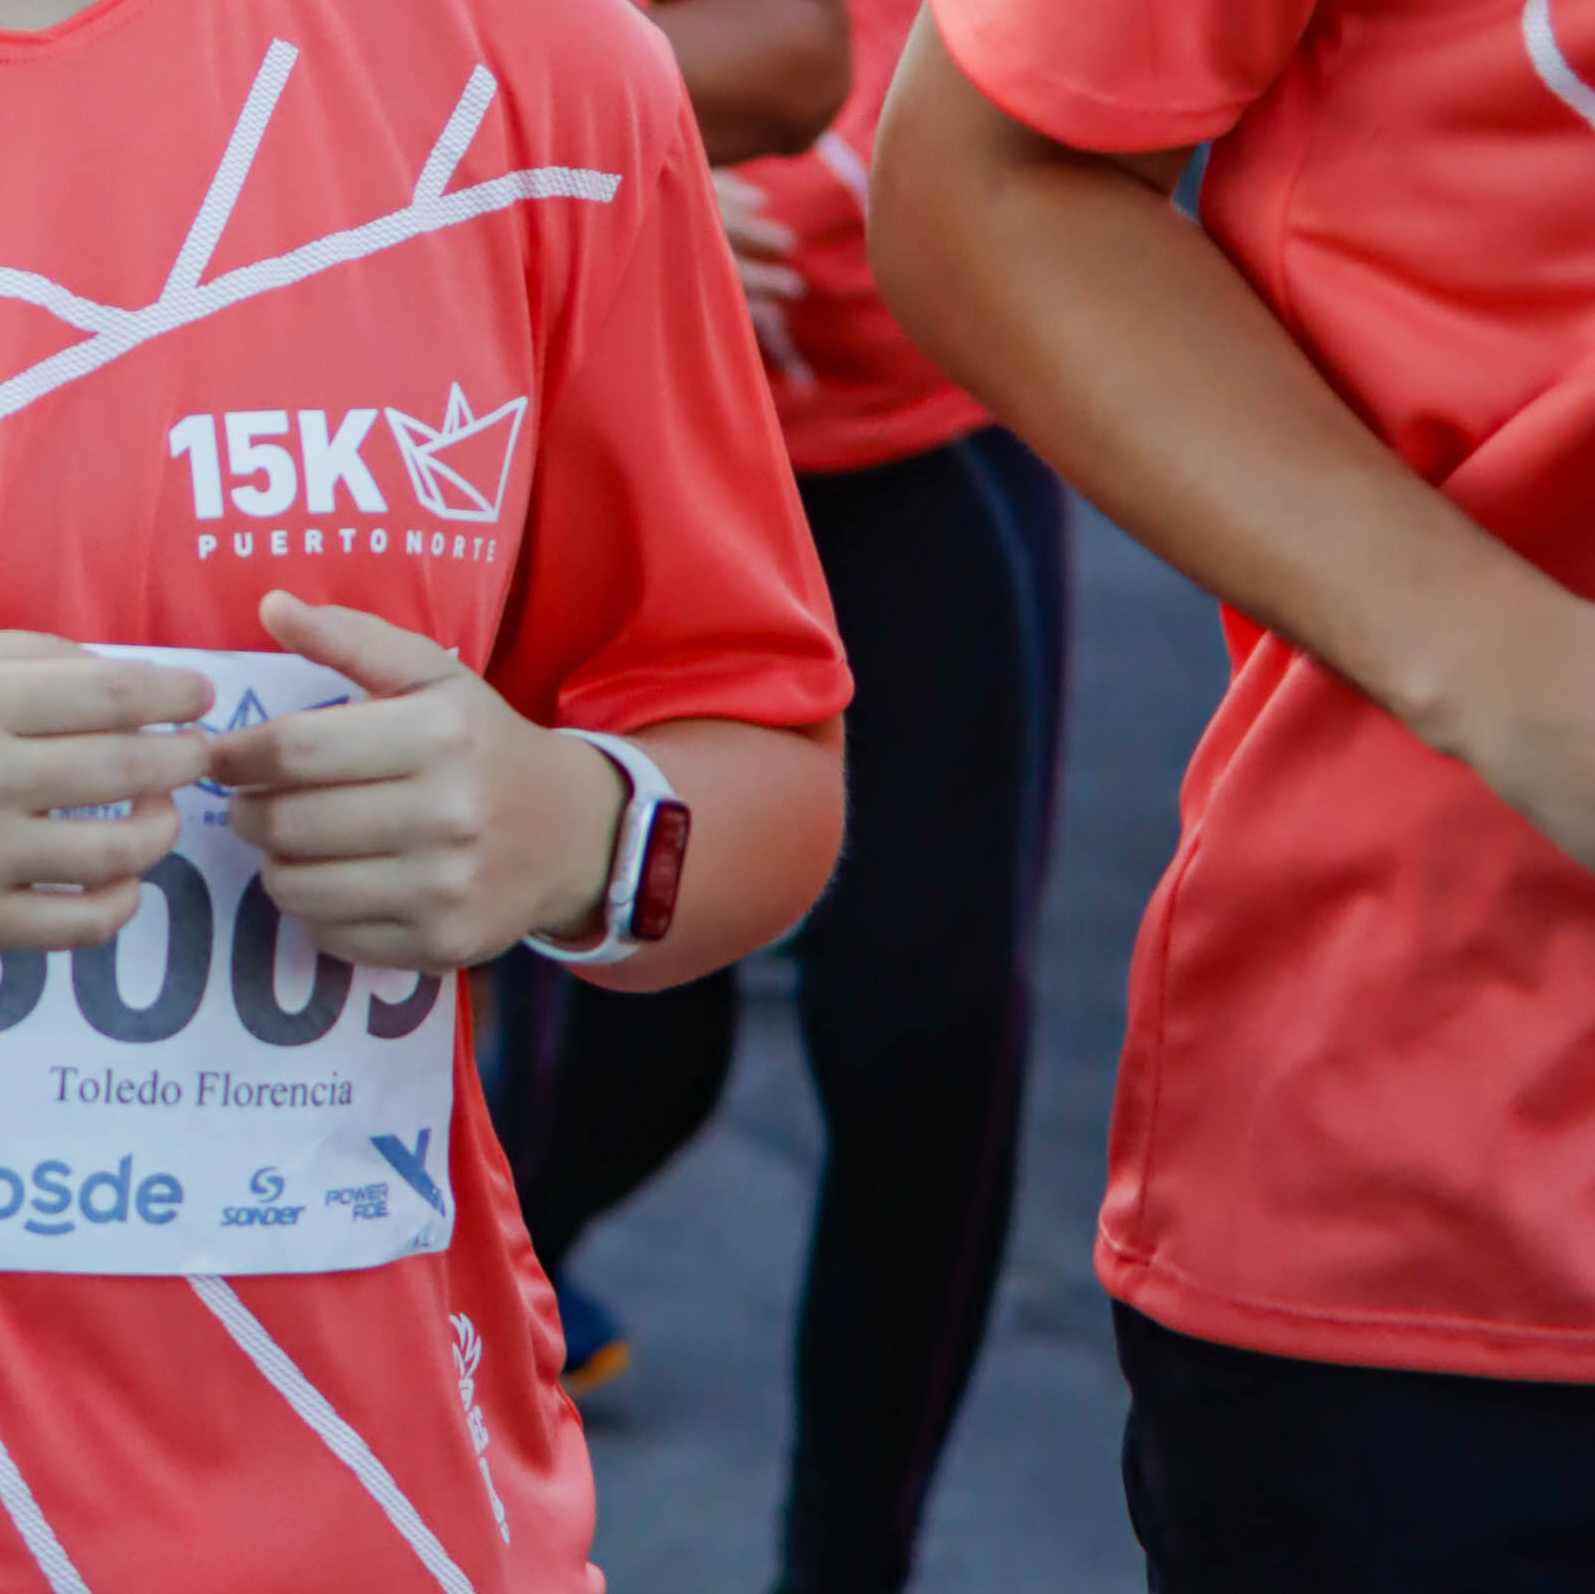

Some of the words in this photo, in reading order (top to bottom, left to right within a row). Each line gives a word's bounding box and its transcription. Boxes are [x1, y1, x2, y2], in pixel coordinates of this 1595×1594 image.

[168, 408, 388, 520] 15K
[198, 527, 388, 560] PUERTO
[406, 530, 496, 563] NORTE
[50, 1065, 182, 1105] Toledo
[196, 1070, 355, 1107] Florencia
